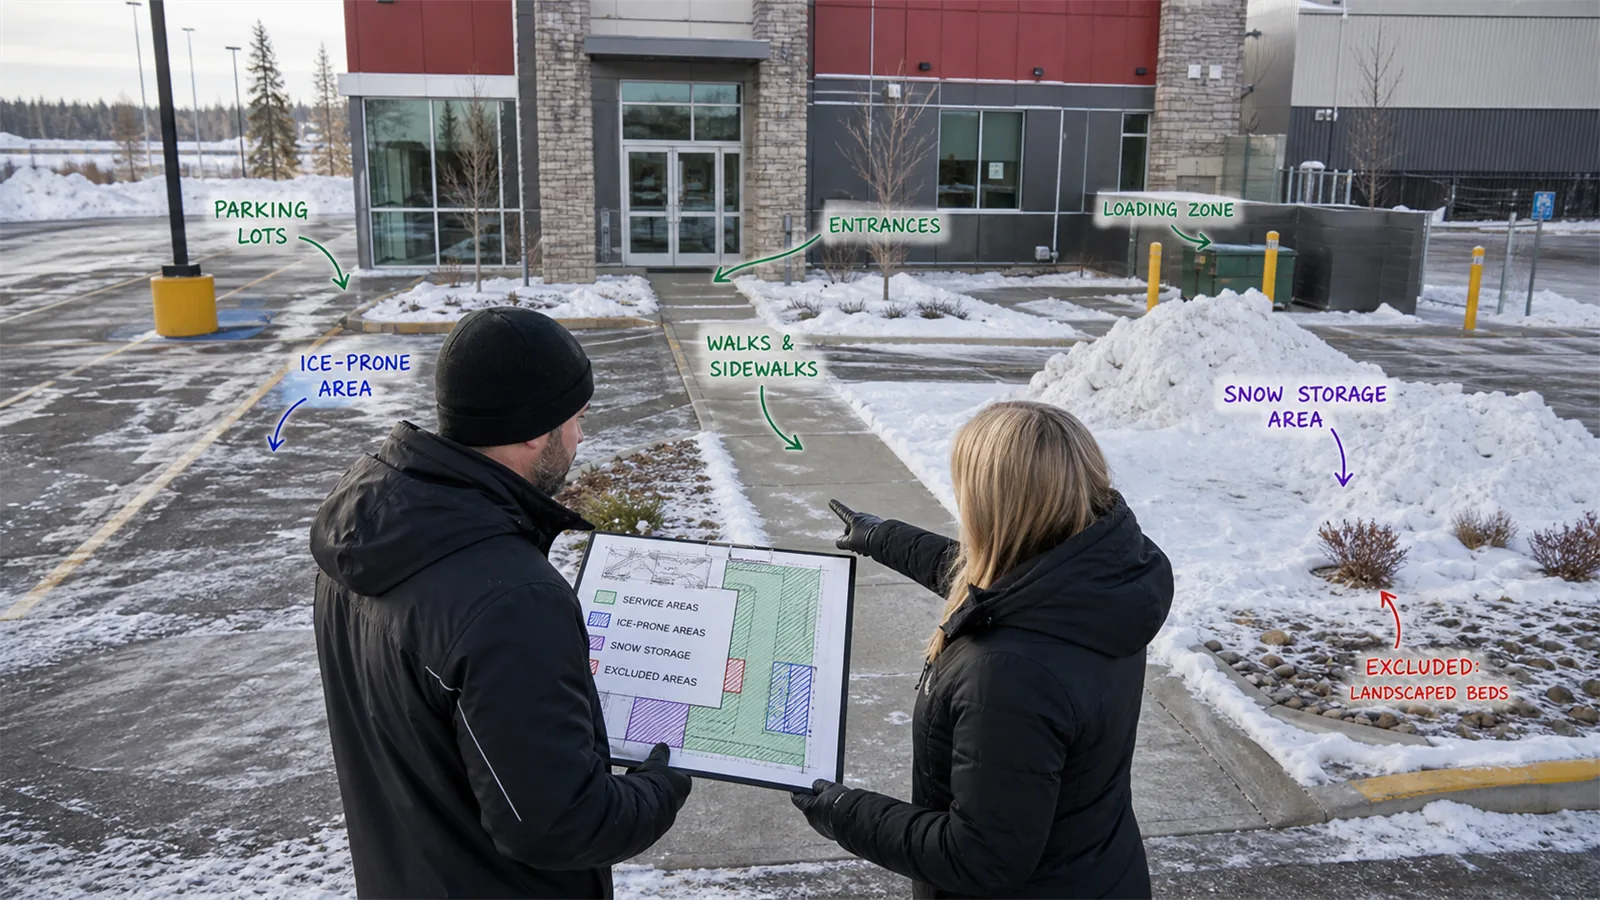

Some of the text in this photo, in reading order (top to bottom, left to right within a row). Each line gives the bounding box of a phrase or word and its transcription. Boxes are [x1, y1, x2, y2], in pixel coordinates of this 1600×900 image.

[622, 595, 699, 612] SERVICE AREAS
[616, 618, 706, 637] ICE-PRONE AREAS
[610, 641, 691, 660] SNOW STORAGE
[604, 665, 698, 687] EXCLUDED AREAS
